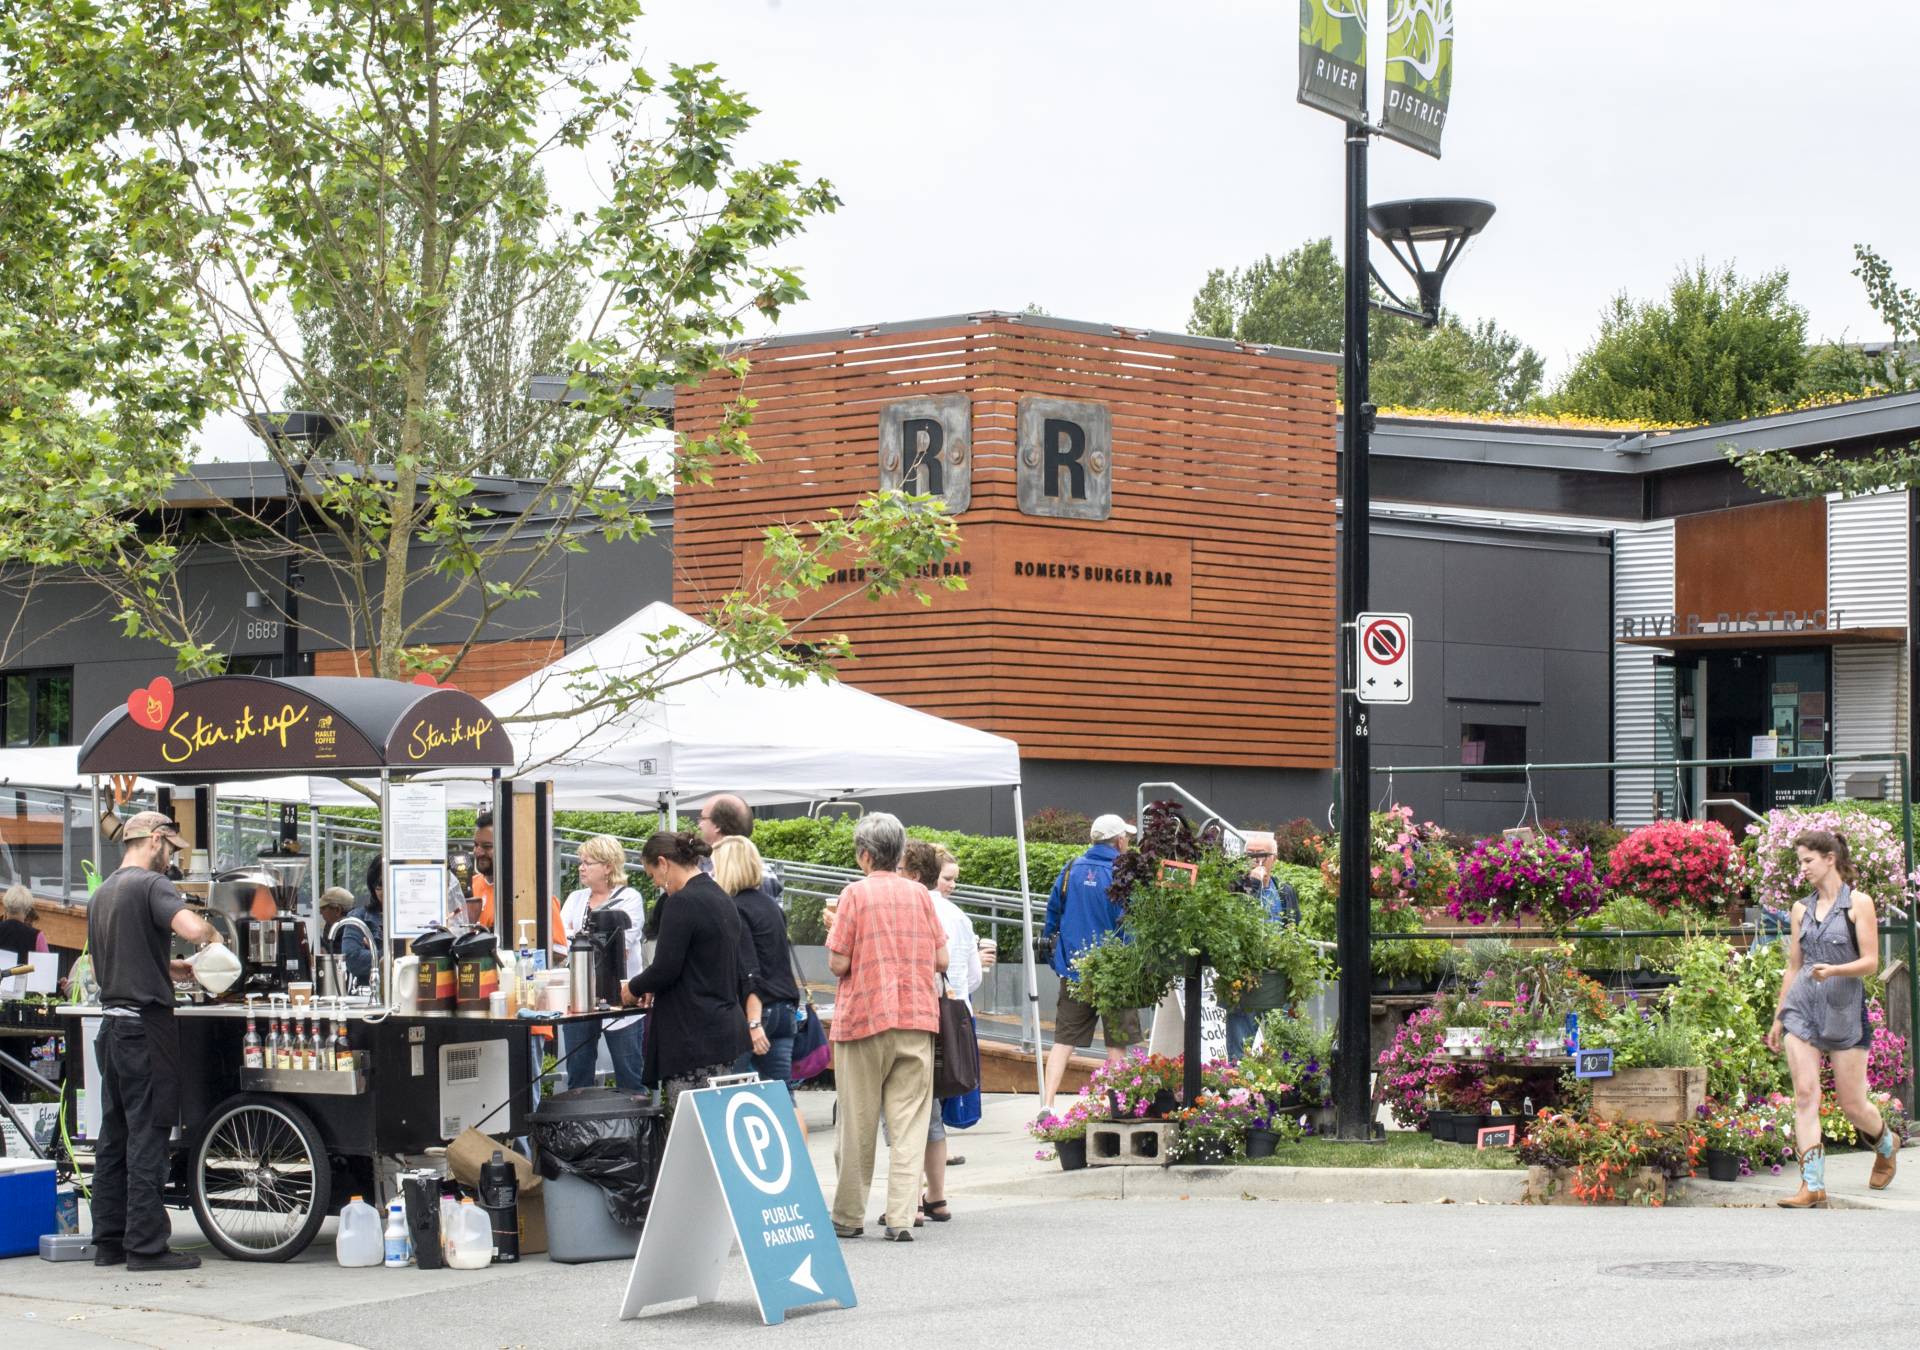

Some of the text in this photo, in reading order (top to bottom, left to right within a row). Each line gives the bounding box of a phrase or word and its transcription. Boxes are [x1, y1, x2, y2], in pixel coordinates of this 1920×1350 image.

[1316, 58, 1358, 91] RIVER
[1389, 89, 1448, 129] DISTRICT
[903, 419, 944, 497] R
[1043, 418, 1086, 500] R
[943, 561, 971, 577] BAR
[1014, 561, 1172, 587] ROMER'S BURGER BAR
[247, 621, 278, 640] 8683
[1622, 609, 1846, 637] RIVER DISTRICT
[1355, 725, 1369, 737] 86
[1360, 713, 1366, 724] 9
[315, 737, 336, 745] COFFEE
[743, 1115, 770, 1171] P
[761, 1203, 804, 1226] PUBLIC
[762, 1223, 816, 1248] PARKING
